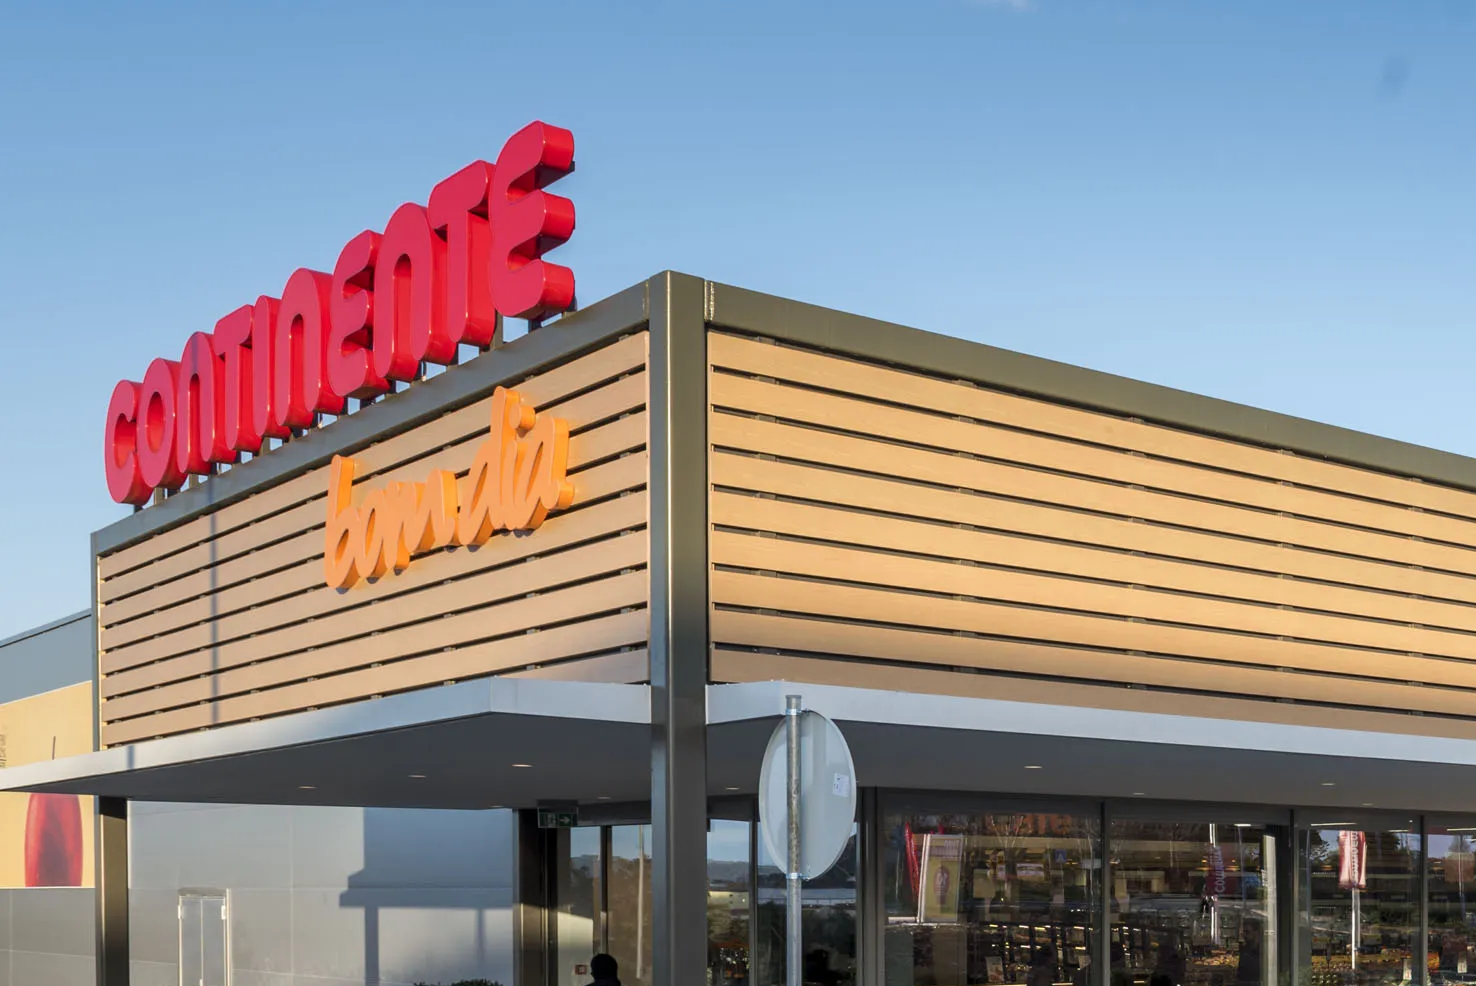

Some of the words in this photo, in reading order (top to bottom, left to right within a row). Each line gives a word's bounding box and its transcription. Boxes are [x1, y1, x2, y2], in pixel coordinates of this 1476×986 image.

[105, 120, 575, 504] CONTINENTE
[325, 455, 459, 590] bom
[458, 386, 575, 548] dia
